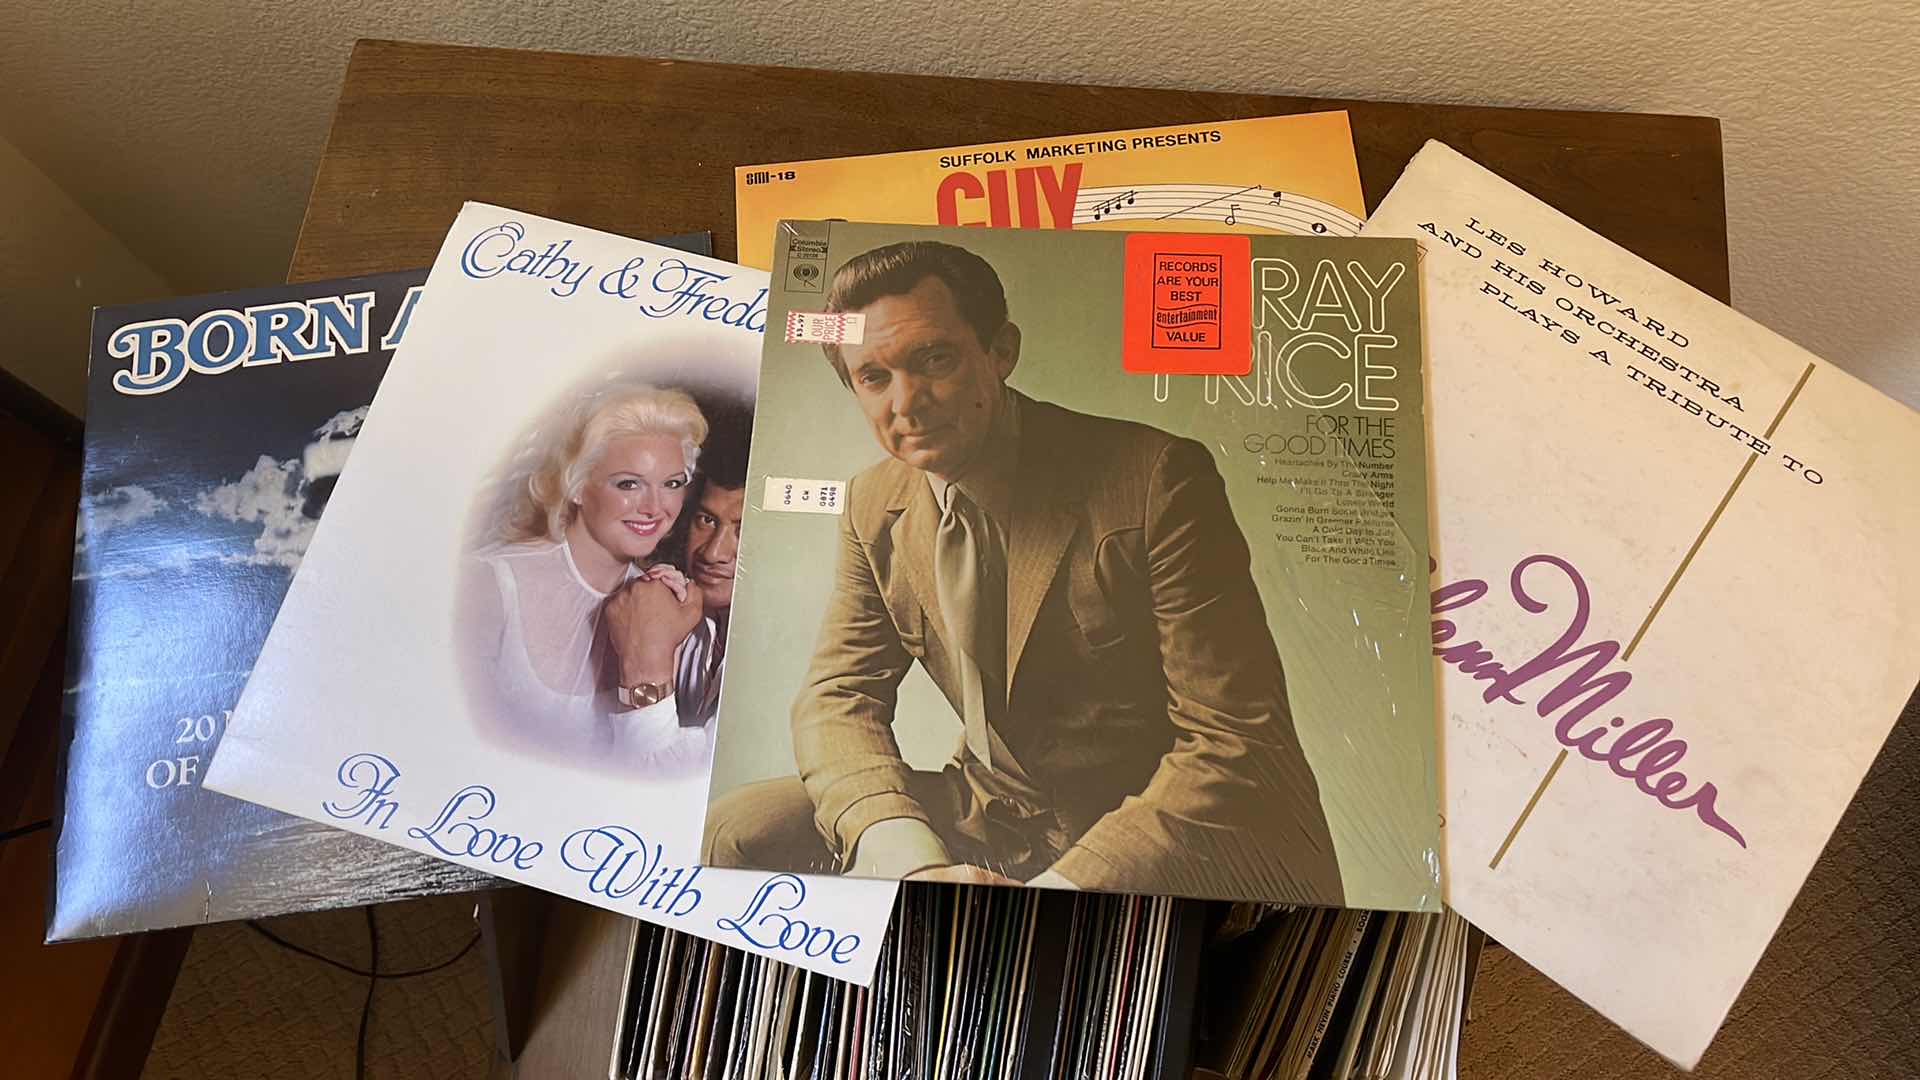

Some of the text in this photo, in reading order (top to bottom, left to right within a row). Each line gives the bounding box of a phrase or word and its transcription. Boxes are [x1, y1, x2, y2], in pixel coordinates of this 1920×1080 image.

[939, 130, 1222, 168] SUFFOLK MARKETING PRESENTS
[461, 221, 593, 297] Cathy
[599, 256, 645, 299] &
[1159, 261, 1217, 272] RECORDS
[1157, 276, 1218, 286] ARE YOUR
[1465, 217, 1690, 349] LES HOWARD
[1170, 291, 1202, 301] BEST
[1251, 257, 1406, 333] RAY
[811, 317, 823, 337] OUR
[823, 315, 837, 341] PRICE
[1156, 308, 1217, 324] entertainment
[1417, 221, 1745, 412] AND HIS ORCHESTRA
[108, 291, 376, 396] BORN
[1166, 332, 1206, 342] VALUE
[1154, 331, 1400, 412] ICE
[1480, 281, 1825, 486] PLAYS A TRIBUTE TO
[1306, 414, 1395, 437] FOR THE
[1244, 433, 1395, 459] GOOD TIMES
[1359, 461, 1394, 470] Number
[1257, 477, 1277, 485] Help
[1370, 480, 1394, 489] Night
[1276, 504, 1305, 513] Gonna
[1307, 506, 1329, 514] Burn
[1276, 533, 1294, 542] You
[1296, 534, 1319, 543] Can't
[1321, 535, 1344, 544] Take
[1305, 554, 1320, 562] For
[1323, 555, 1340, 563] The
[1483, 554, 1747, 849] Miller
[176, 714, 216, 744] 20
[146, 755, 200, 789] OF
[322, 753, 401, 830] In
[408, 785, 543, 871] Love
[560, 825, 702, 917] With
[717, 873, 860, 965] Love
